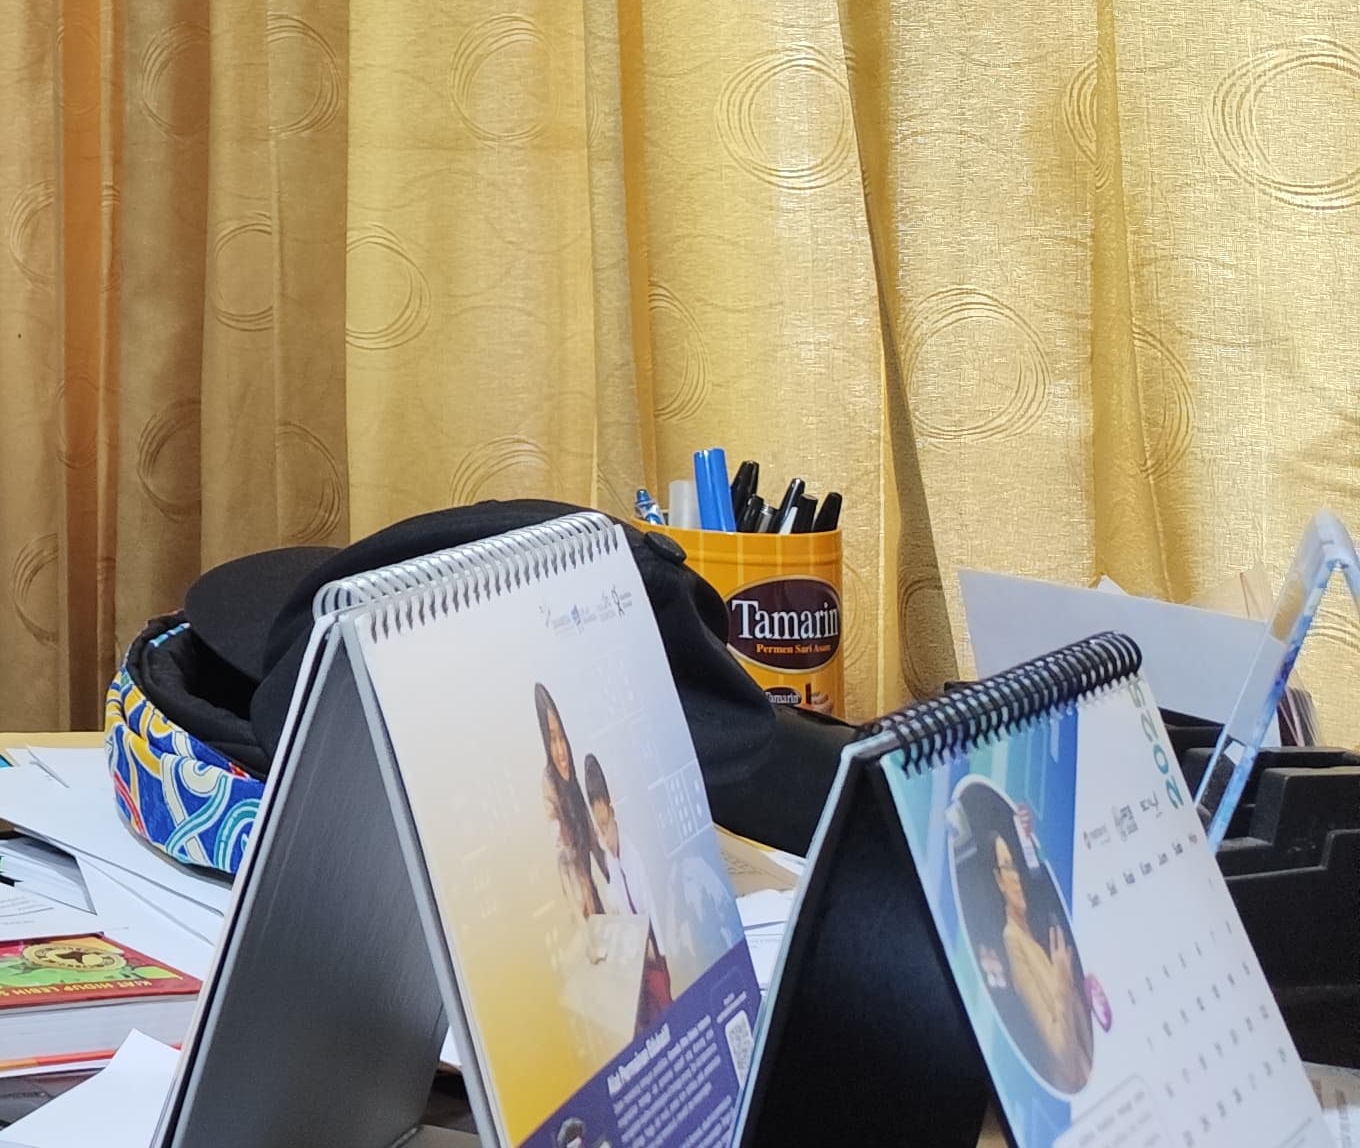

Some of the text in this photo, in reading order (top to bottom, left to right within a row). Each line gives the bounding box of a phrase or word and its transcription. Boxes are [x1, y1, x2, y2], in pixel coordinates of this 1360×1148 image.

[731, 599, 839, 640] Tamarin
[756, 643, 793, 654] Permen
[794, 643, 812, 653] Sari
[1130, 676, 1185, 809] 2025
[12, 984, 59, 997] LEBIH
[63, 980, 114, 993] HIDUP
